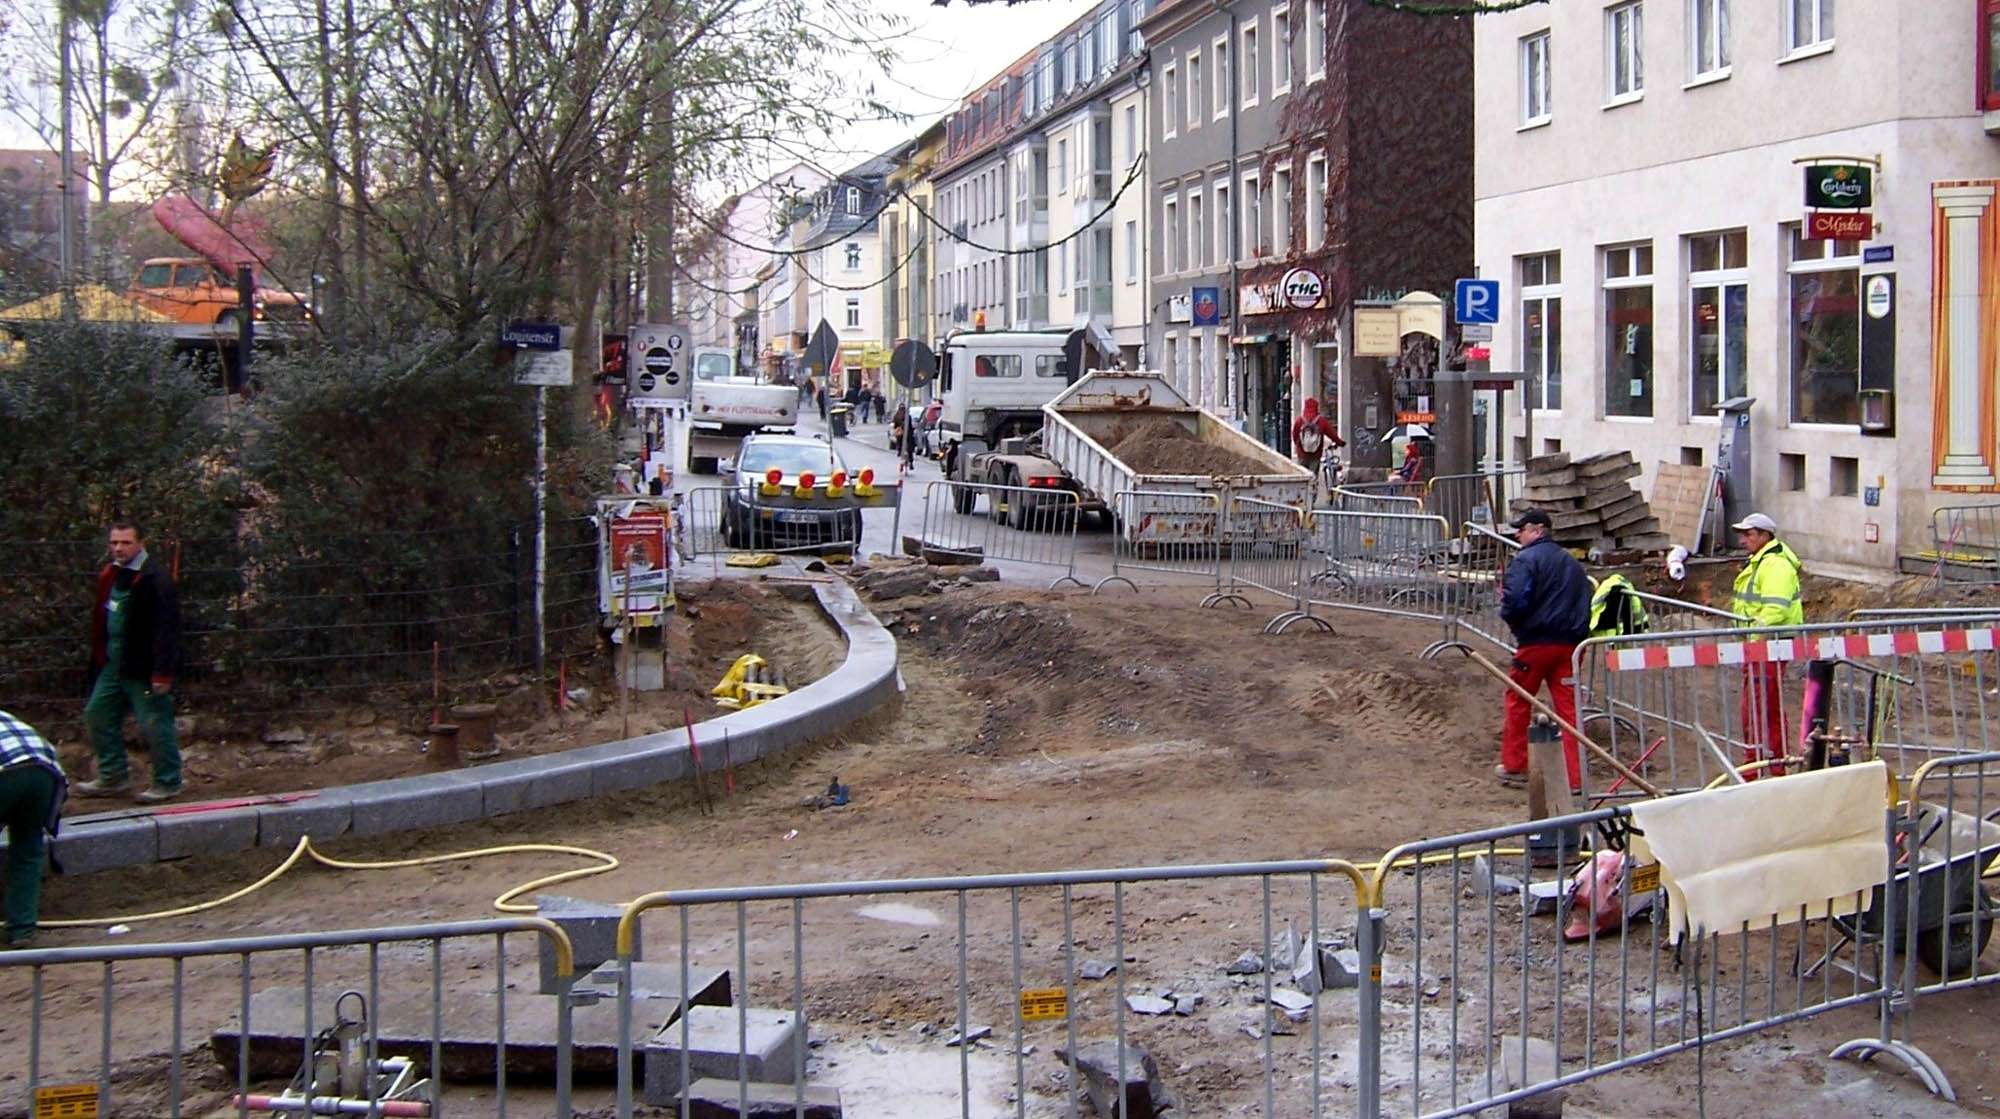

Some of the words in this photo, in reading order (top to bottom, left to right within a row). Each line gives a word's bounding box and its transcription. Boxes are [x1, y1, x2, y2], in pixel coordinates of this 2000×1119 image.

[1821, 178, 1862, 197] Carlsberg
[1289, 283, 1319, 295] THC
[1466, 285, 1489, 318] P
[1740, 414, 1749, 427] P
